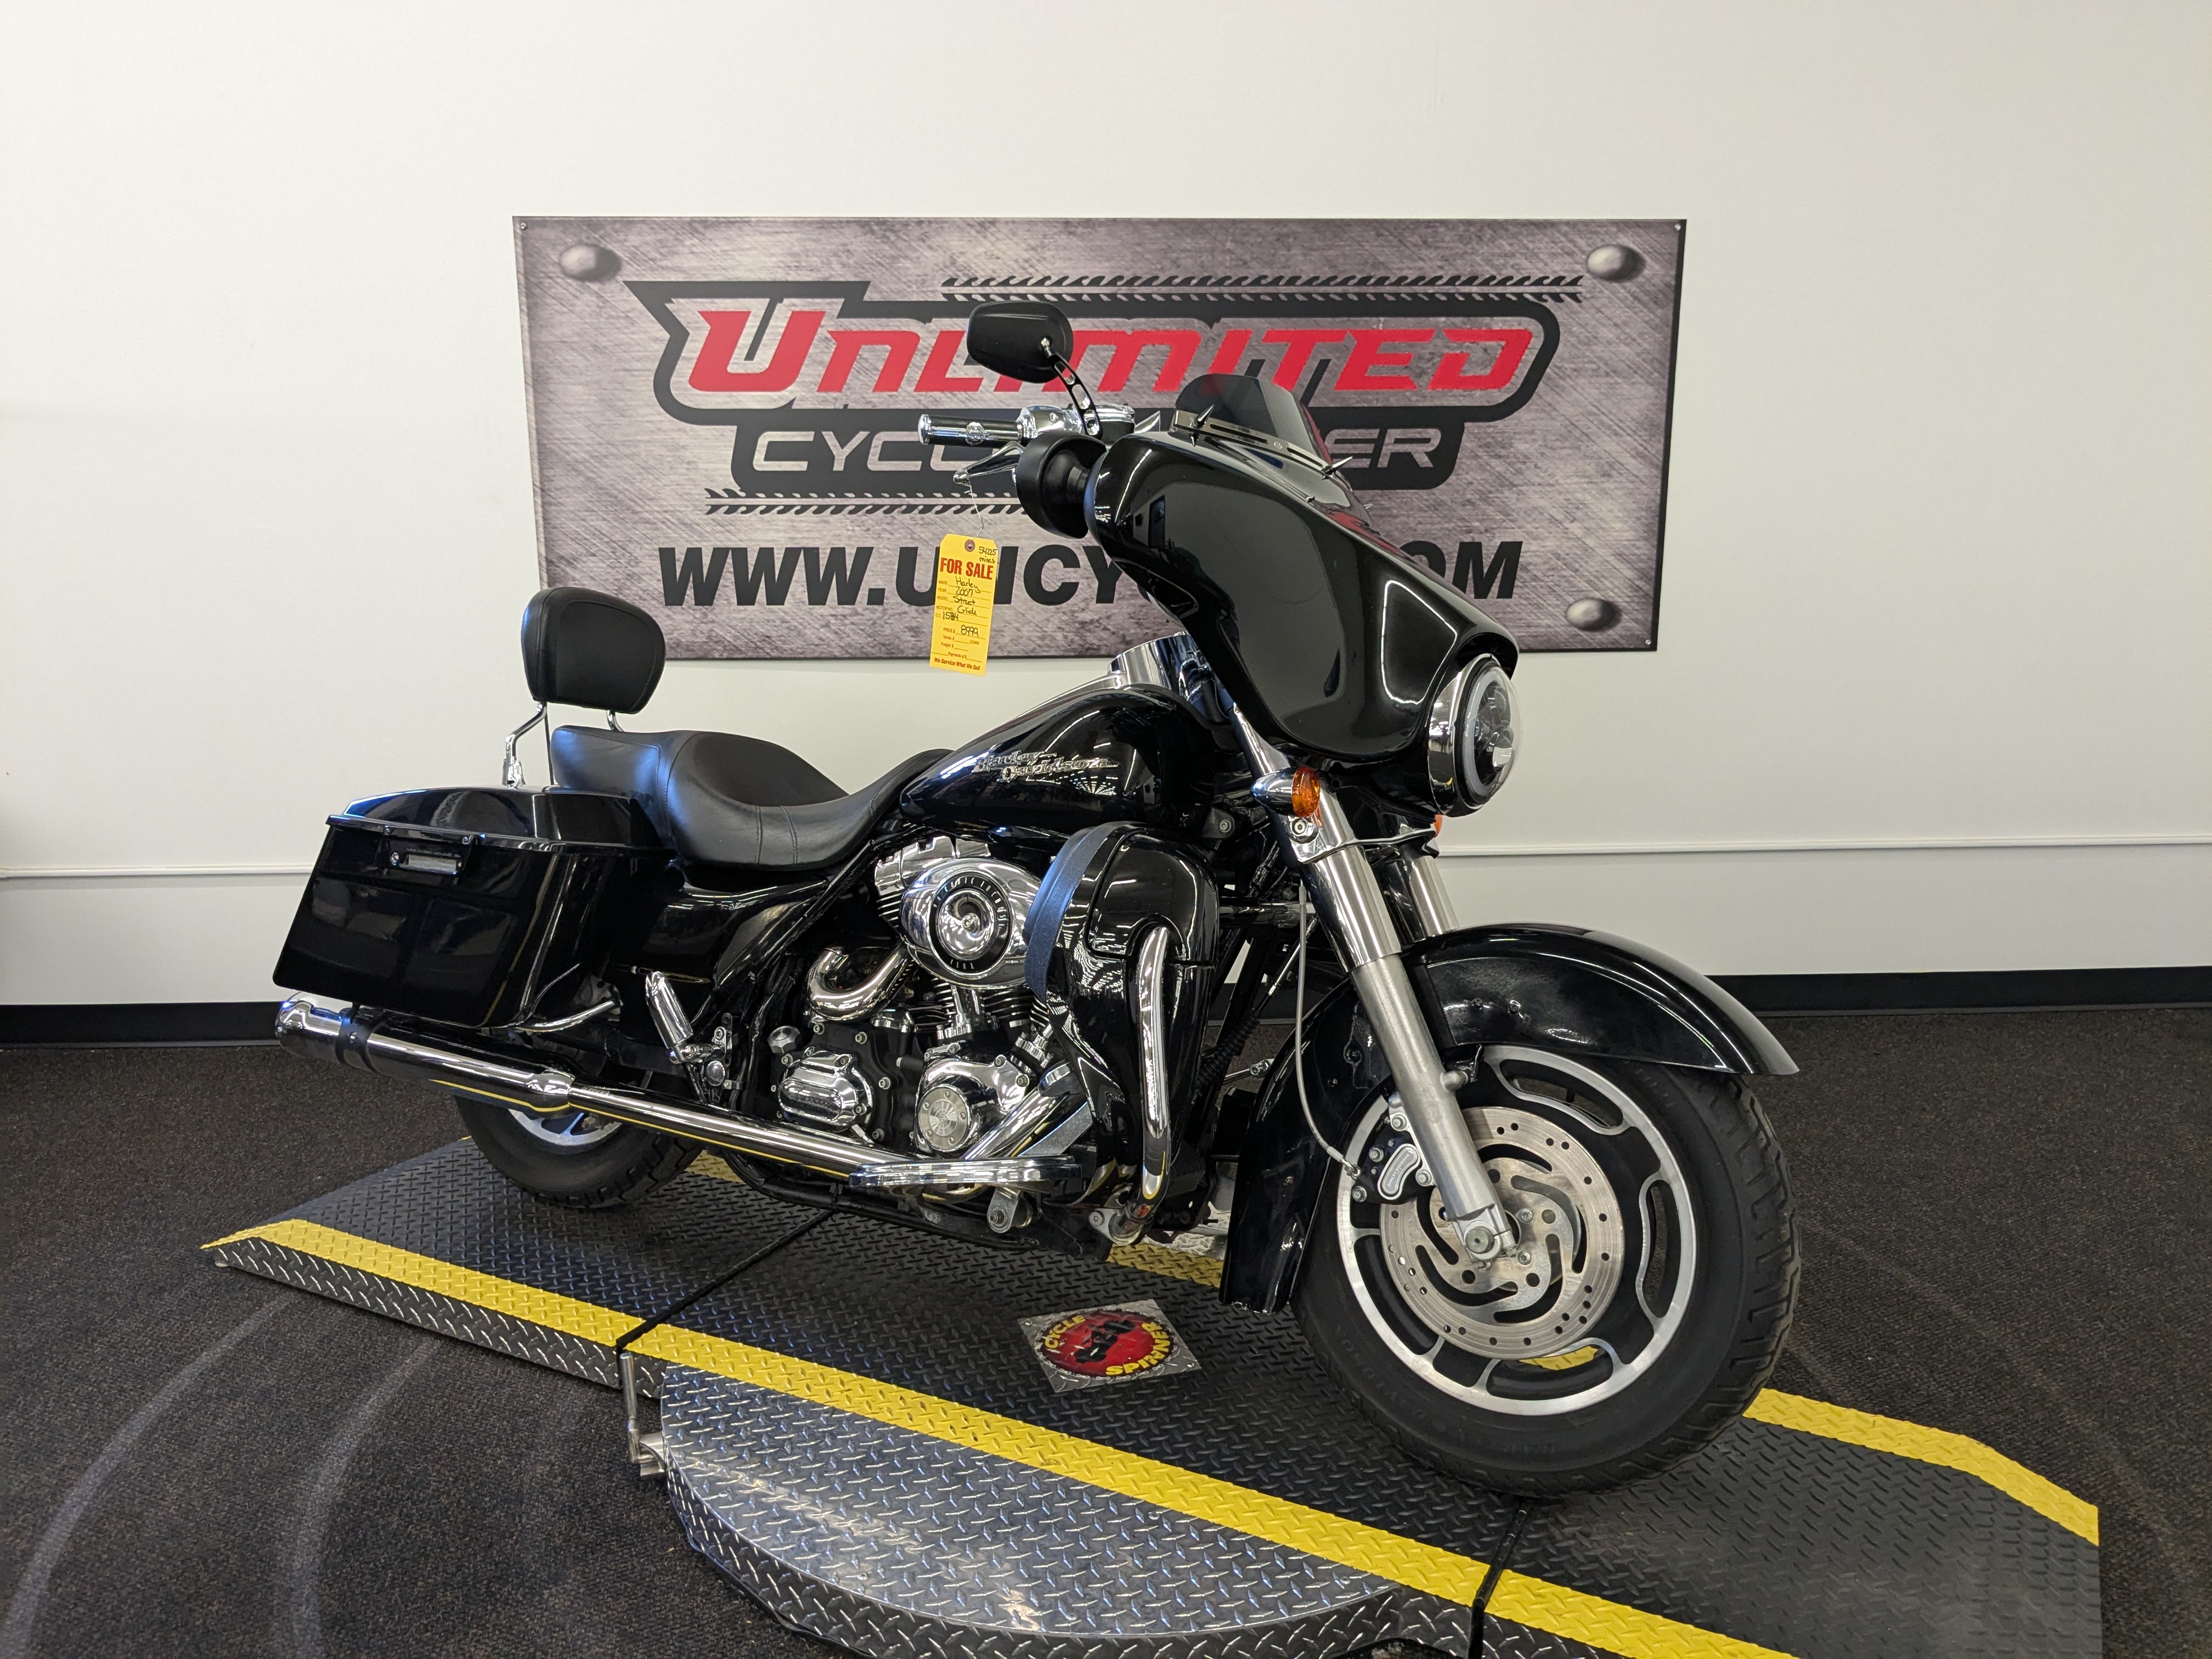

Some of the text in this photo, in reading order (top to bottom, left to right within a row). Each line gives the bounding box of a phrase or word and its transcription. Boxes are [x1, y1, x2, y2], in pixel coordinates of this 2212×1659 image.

[689, 311, 1533, 392] UNLMITED
[979, 546, 997, 556] 54225
[940, 557, 994, 580] FOR SALE
[955, 575, 981, 593] Harley
[955, 586, 973, 596] 2007
[952, 596, 976, 605] Street
[961, 624, 979, 637] 8999
[1045, 1314, 1086, 1349] CYCLE
[1105, 1321, 1171, 1376] SPINNER
